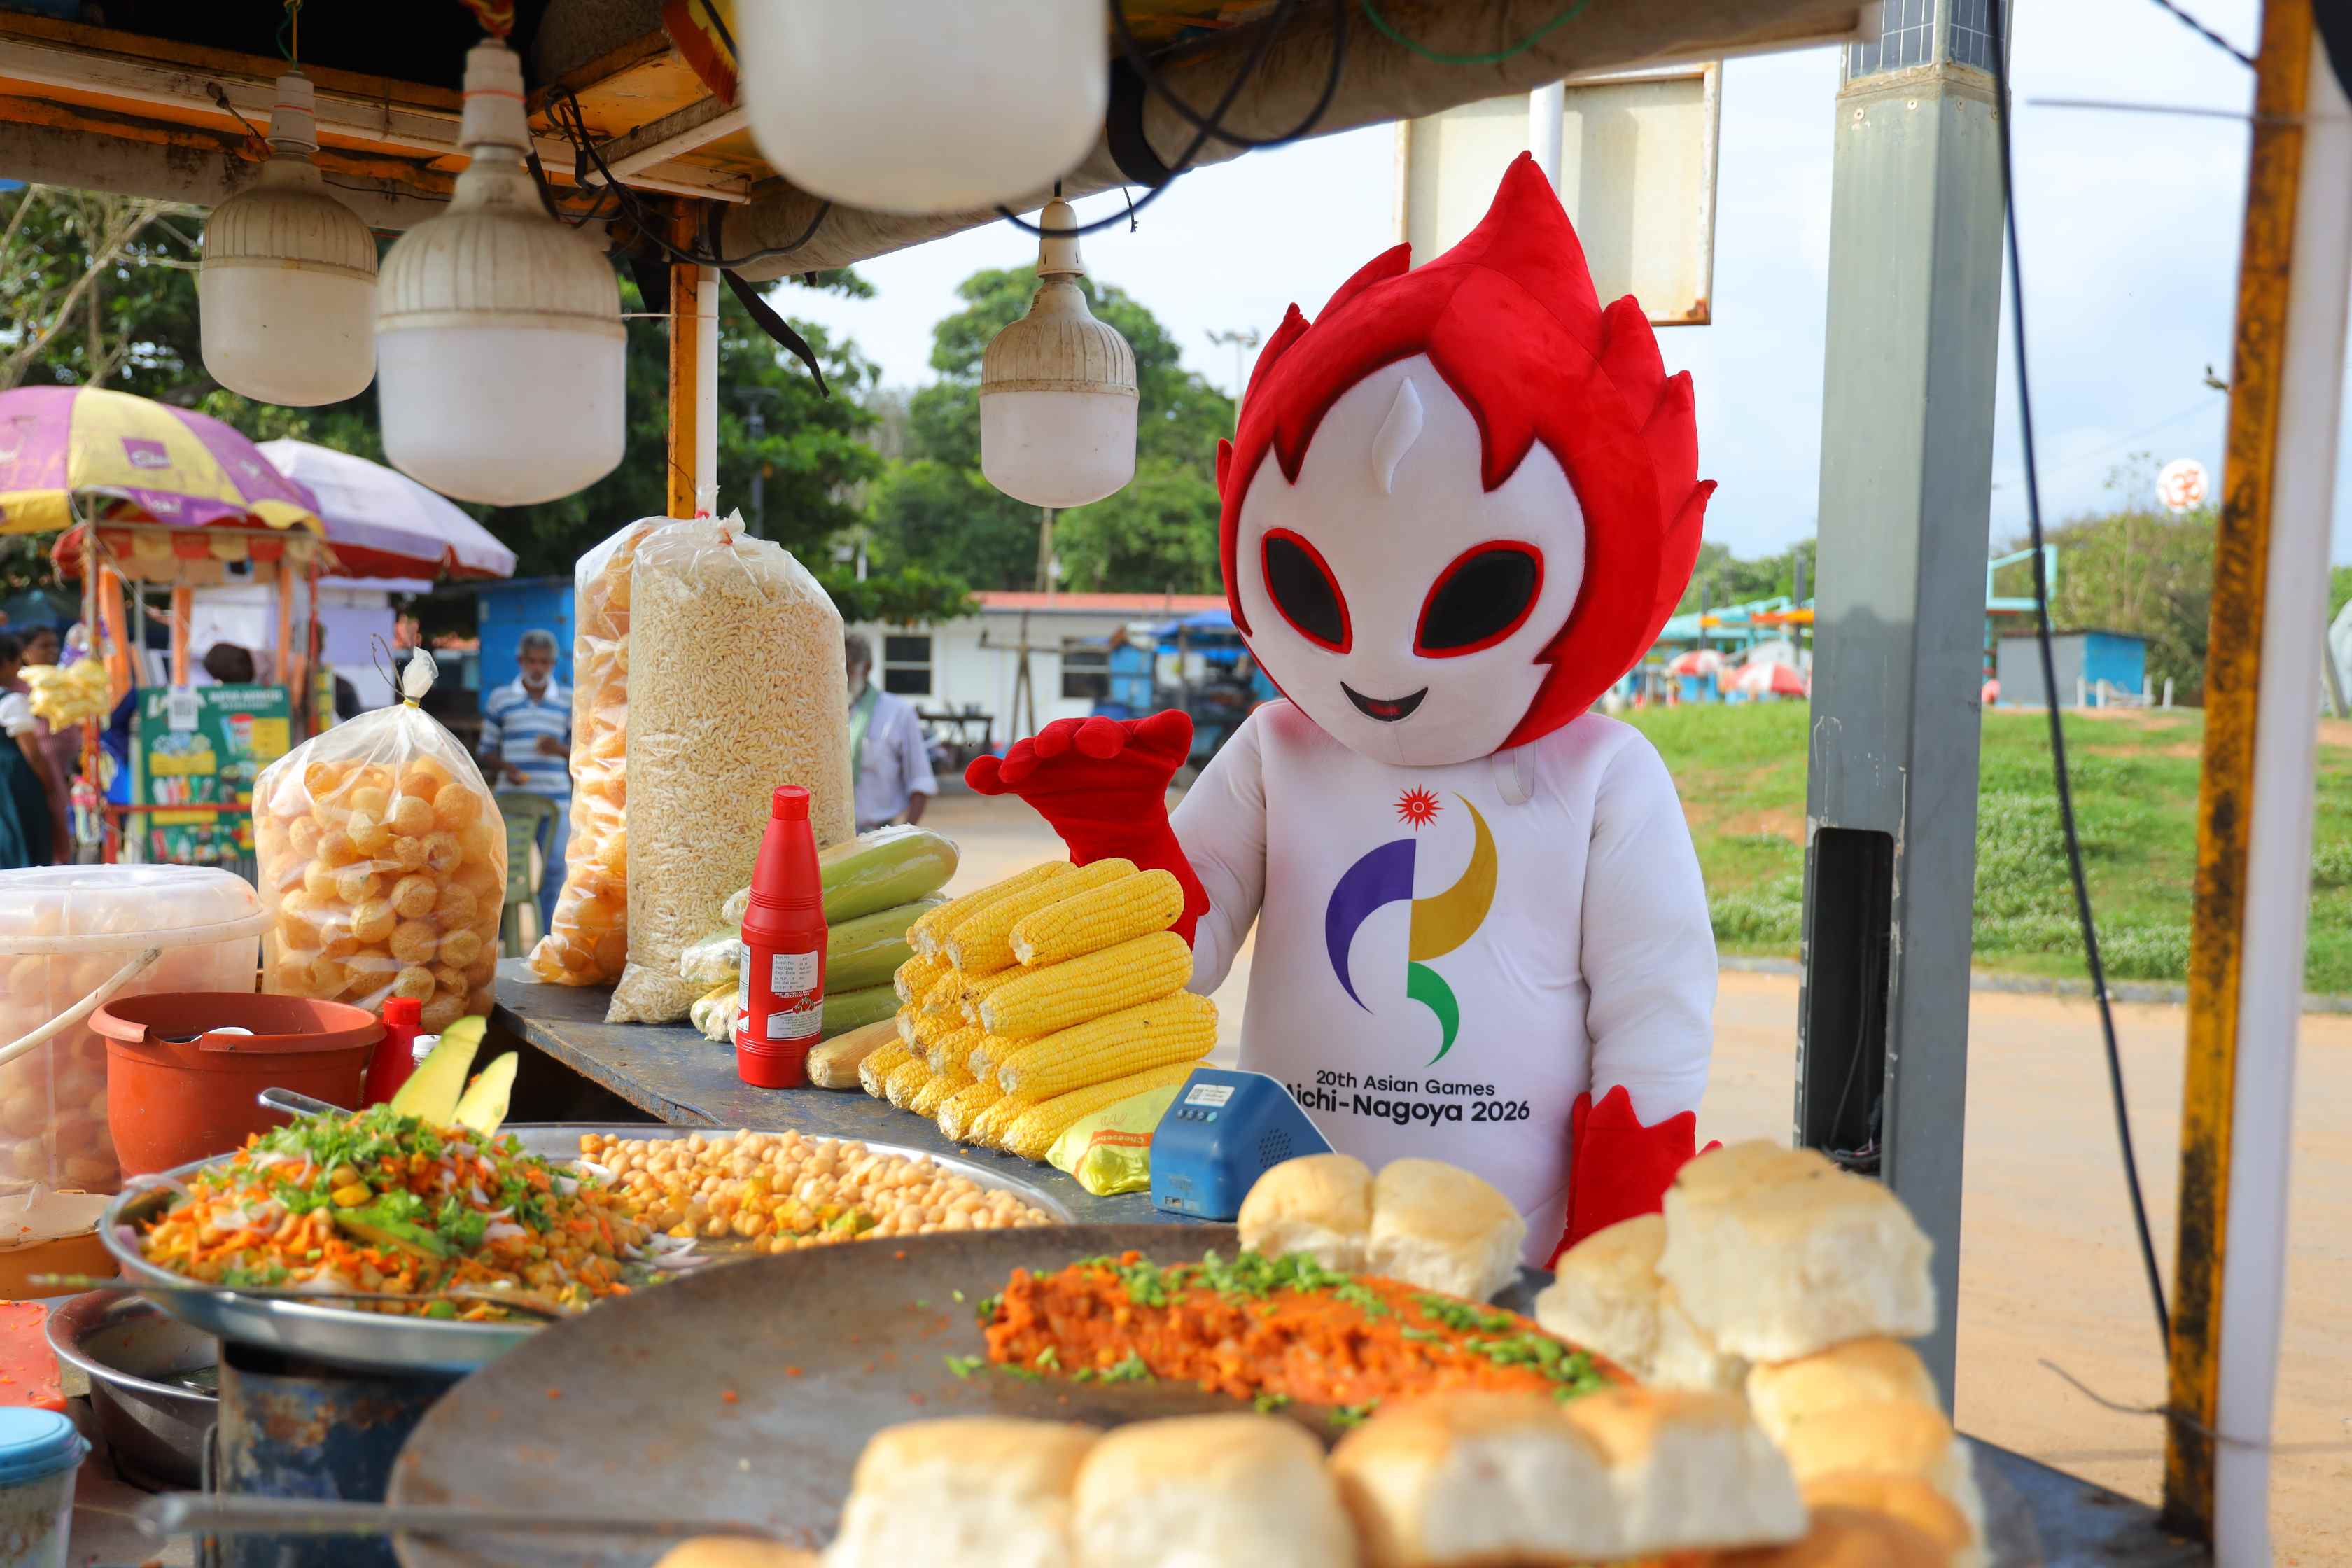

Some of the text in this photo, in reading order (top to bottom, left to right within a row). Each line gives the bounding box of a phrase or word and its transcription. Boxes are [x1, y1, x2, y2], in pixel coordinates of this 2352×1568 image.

[1316, 1070, 1495, 1096] 20th Asian Games
[1287, 1084, 1530, 1126] ichi-Nagoya 2026
